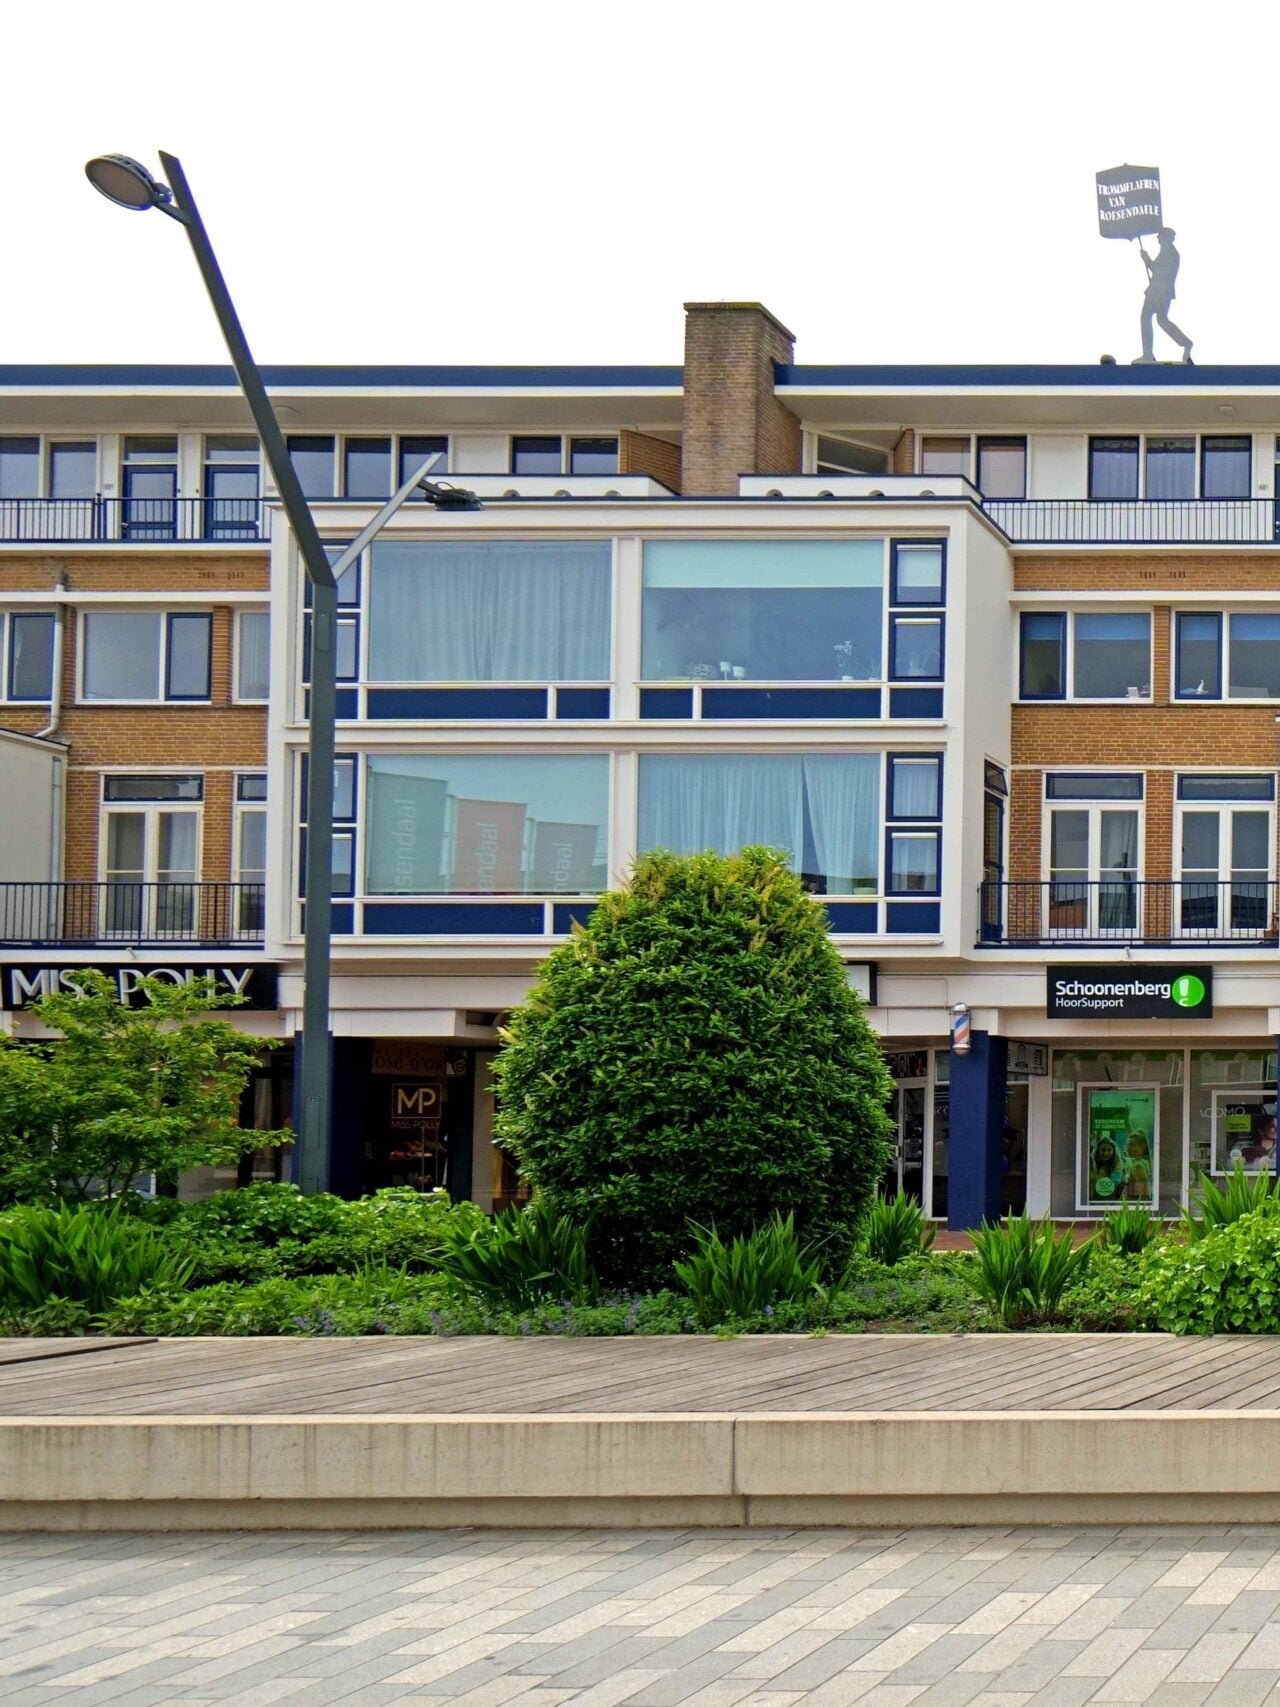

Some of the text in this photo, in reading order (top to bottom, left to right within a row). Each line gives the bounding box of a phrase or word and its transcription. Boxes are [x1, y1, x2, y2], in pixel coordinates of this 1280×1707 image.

[1109, 196, 1126, 208] VAN
[1055, 980, 1171, 999] Schoonenberg
[1055, 997, 1124, 1009] HoorSupport
[397, 1088, 437, 1114] MP
